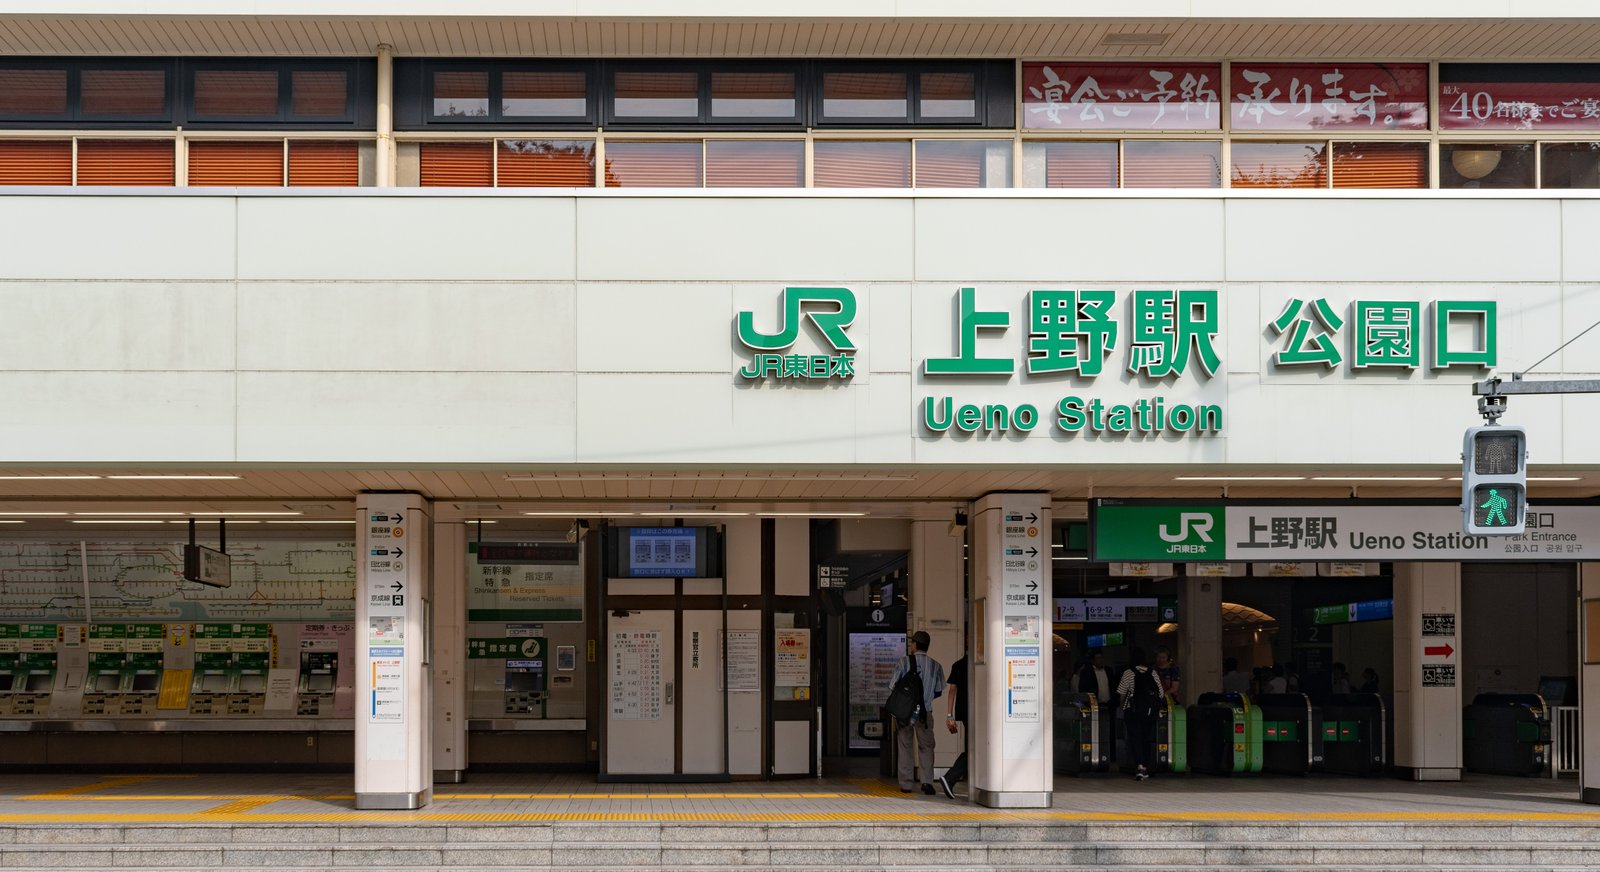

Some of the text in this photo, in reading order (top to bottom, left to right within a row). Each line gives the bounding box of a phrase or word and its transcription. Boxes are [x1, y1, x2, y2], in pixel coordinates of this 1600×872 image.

[1029, 67, 1398, 125] 宴会ご予約 承ります。
[737, 286, 858, 351] JR
[923, 287, 1221, 378] 上野駅
[1270, 297, 1498, 370] 公園口
[740, 353, 856, 379] JR東日本
[924, 395, 1224, 432] Ueno Station
[1159, 512, 1214, 543] JR
[1237, 516, 1338, 549] 上野駅
[1350, 531, 1488, 549] Ueno Station
[1532, 532, 1577, 541] Entrance
[1167, 544, 1207, 554] JR東日本
[482, 566, 553, 581] 新幹線 指定席
[520, 587, 546, 595] Express
